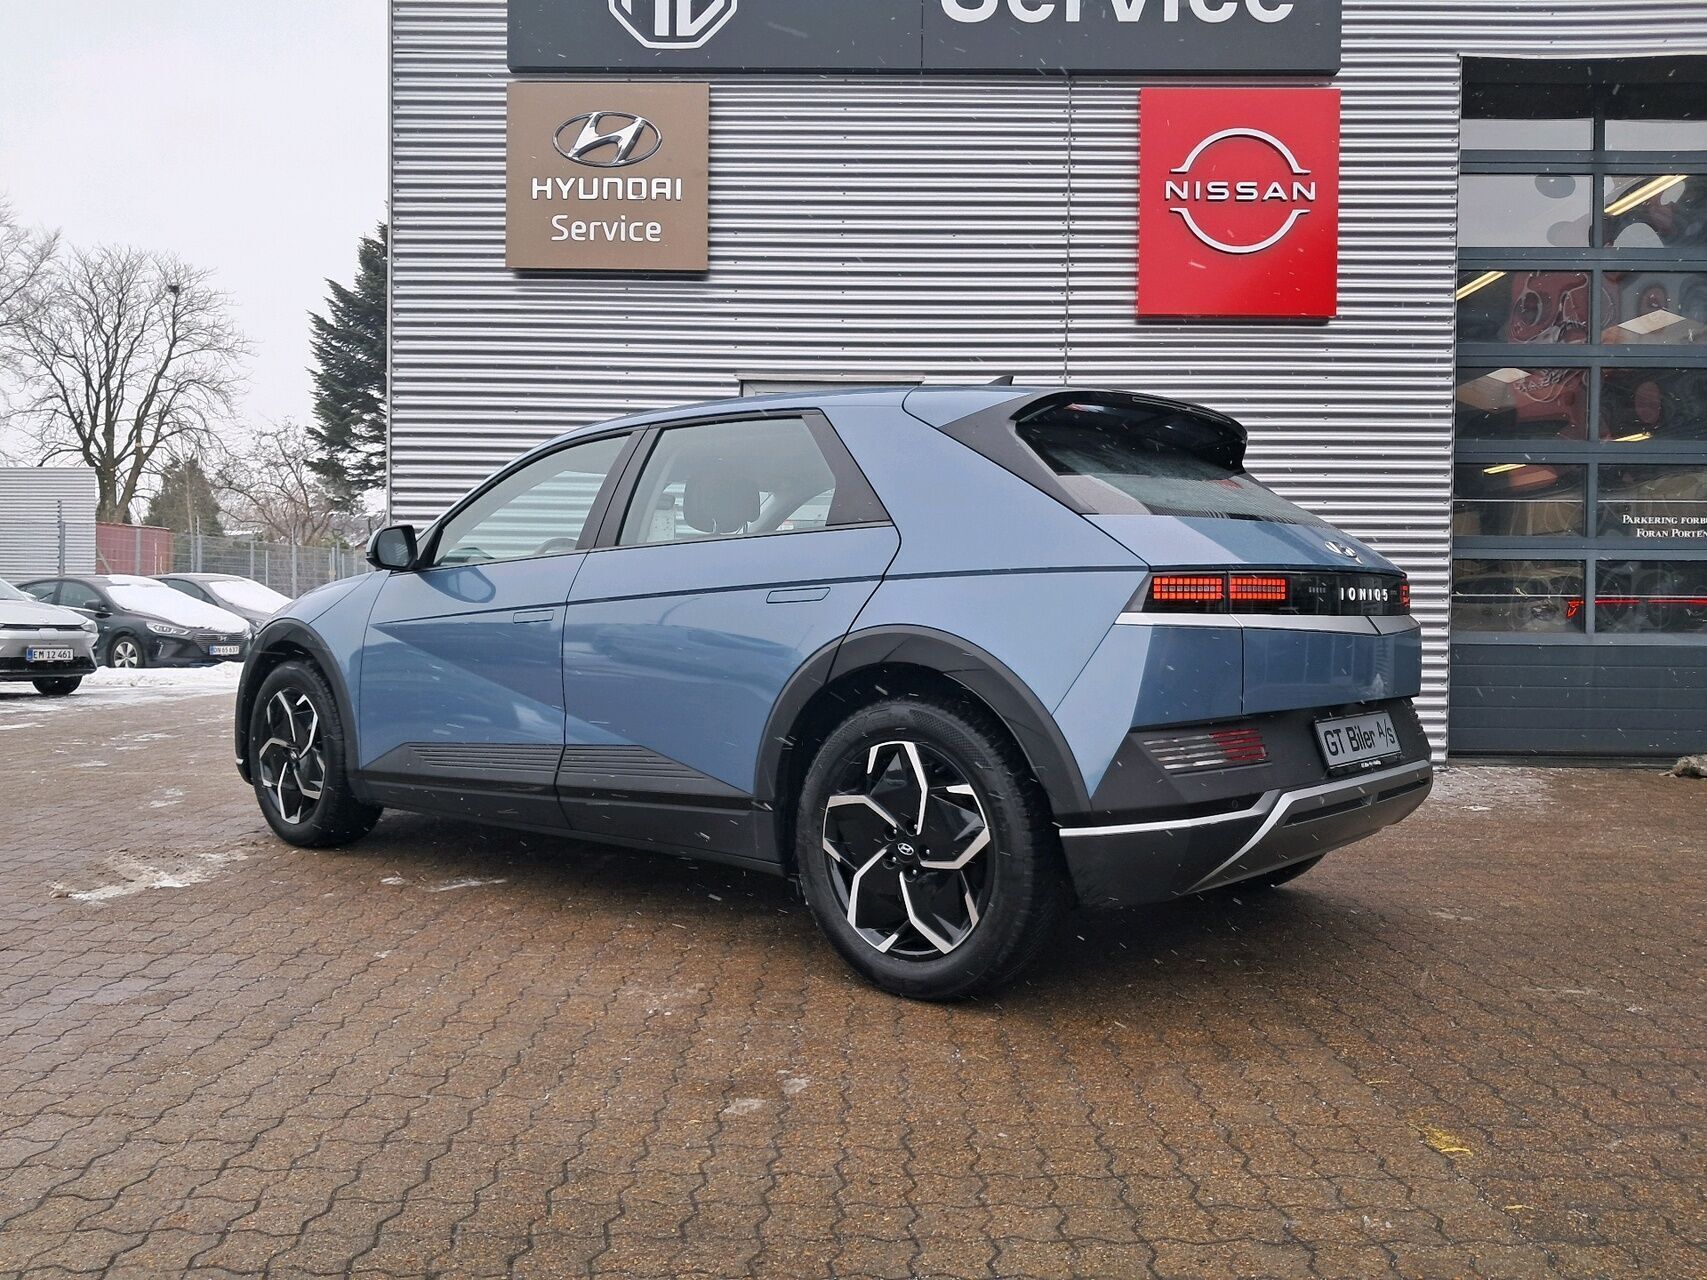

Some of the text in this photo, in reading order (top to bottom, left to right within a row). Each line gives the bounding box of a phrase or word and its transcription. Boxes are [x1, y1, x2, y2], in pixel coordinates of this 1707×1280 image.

[531, 177, 682, 200] HYUNDAI
[1164, 180, 1316, 201] NISSAN
[551, 214, 662, 242] Service
[33, 650, 72, 659] EM 12 461
[1323, 728, 1346, 756] GT
[1345, 725, 1376, 752] Biler
